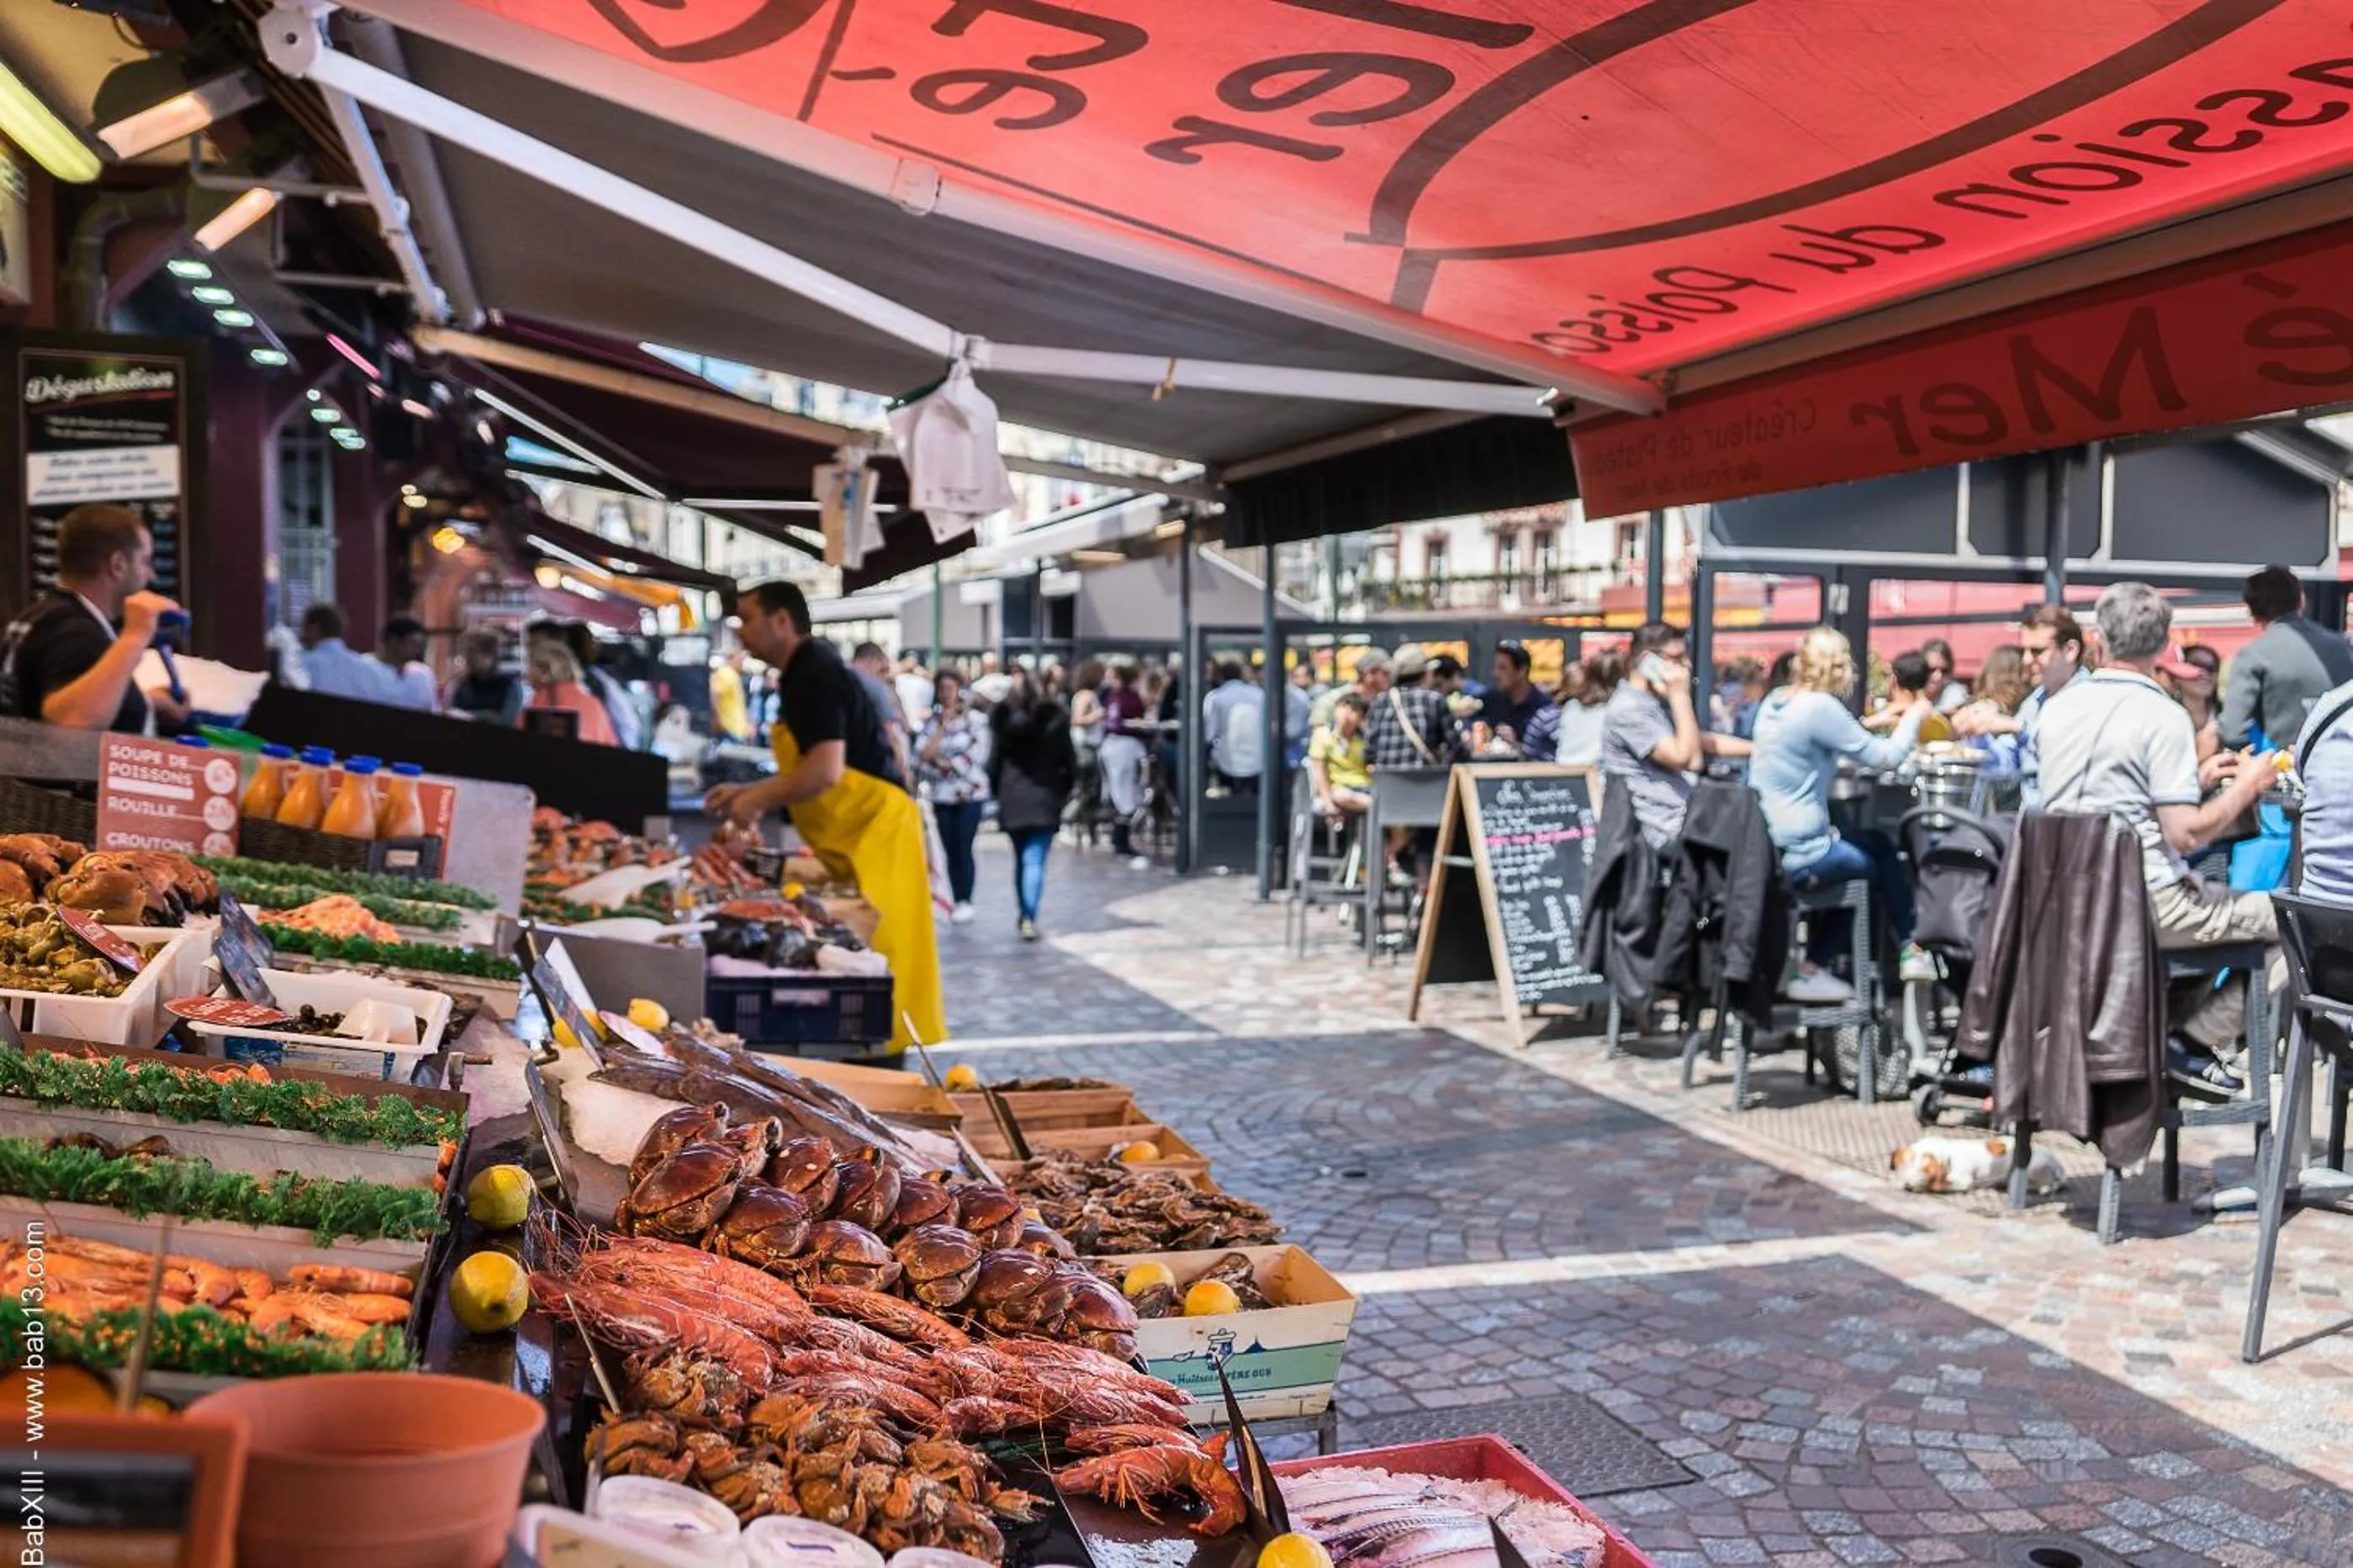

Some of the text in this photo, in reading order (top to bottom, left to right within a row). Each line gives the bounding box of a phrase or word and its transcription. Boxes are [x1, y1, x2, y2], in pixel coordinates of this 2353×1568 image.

[25, 367, 173, 403] Dégustation
[109, 744, 189, 769] SOUPE DE
[108, 760, 193, 786] POISSONS
[106, 795, 177, 817] ROUILLE
[105, 831, 195, 854] CROUTONS
